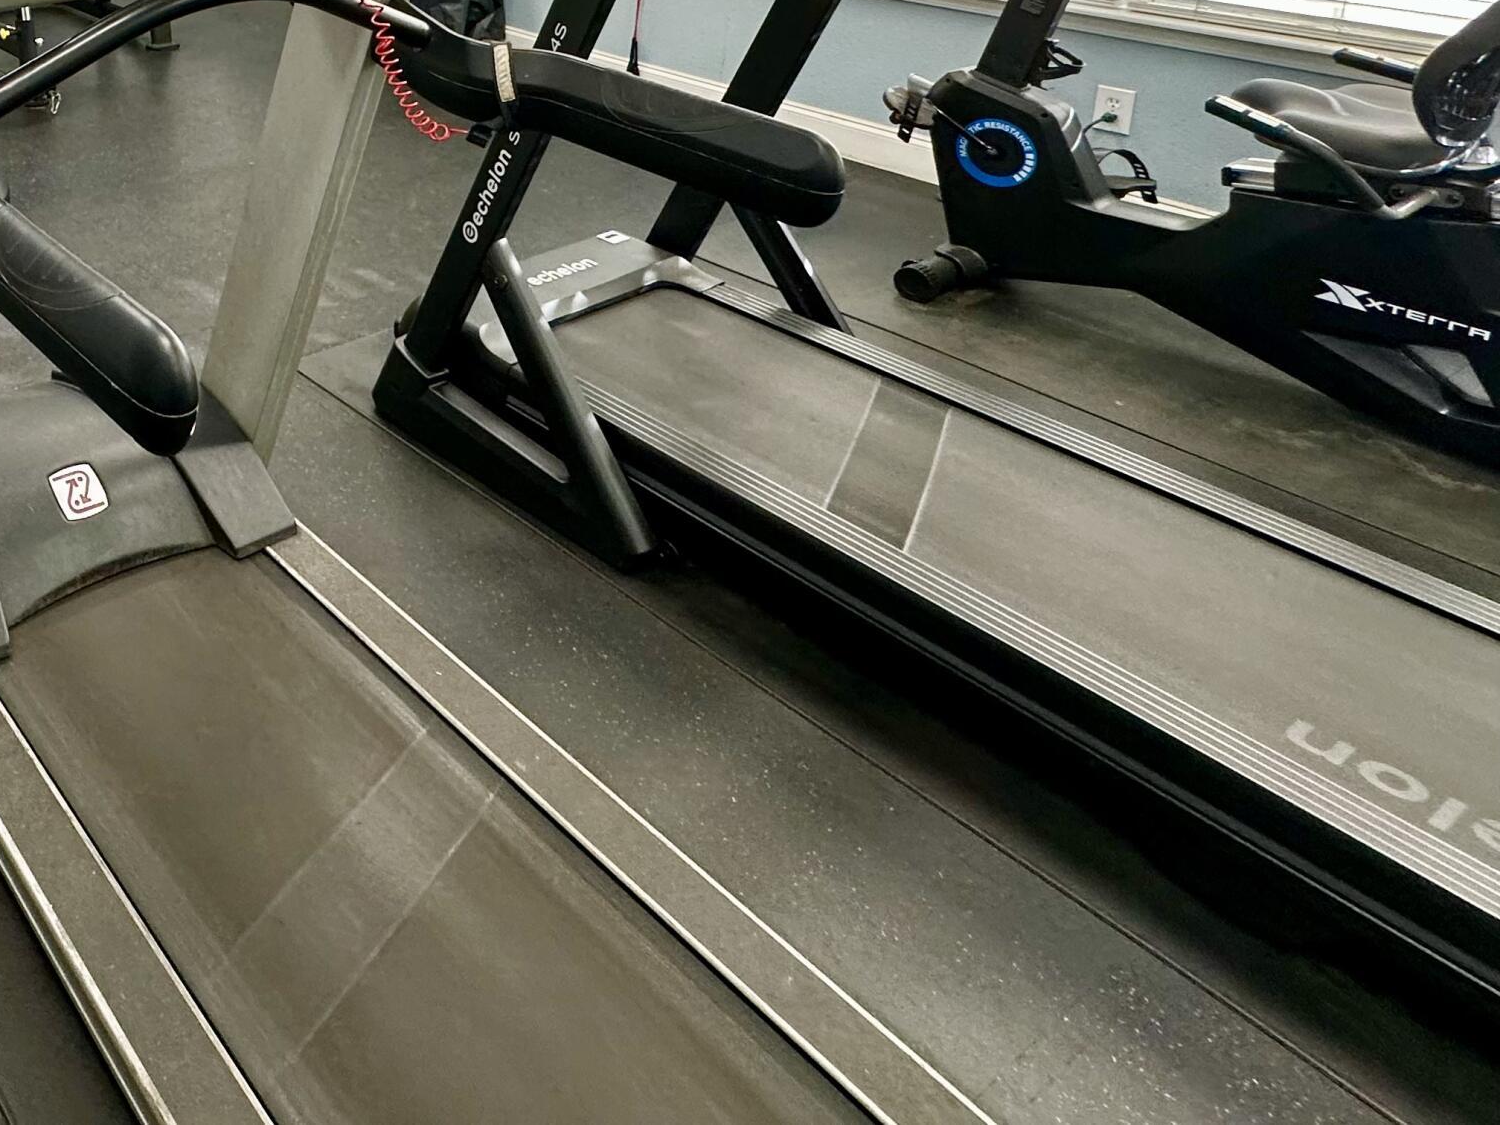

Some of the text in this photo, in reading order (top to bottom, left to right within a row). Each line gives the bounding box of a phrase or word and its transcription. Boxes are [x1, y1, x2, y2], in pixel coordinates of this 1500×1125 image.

[983, 121, 1034, 152] RESISTANCE
[471, 148, 512, 227] echelon
[527, 258, 599, 286] echelon
